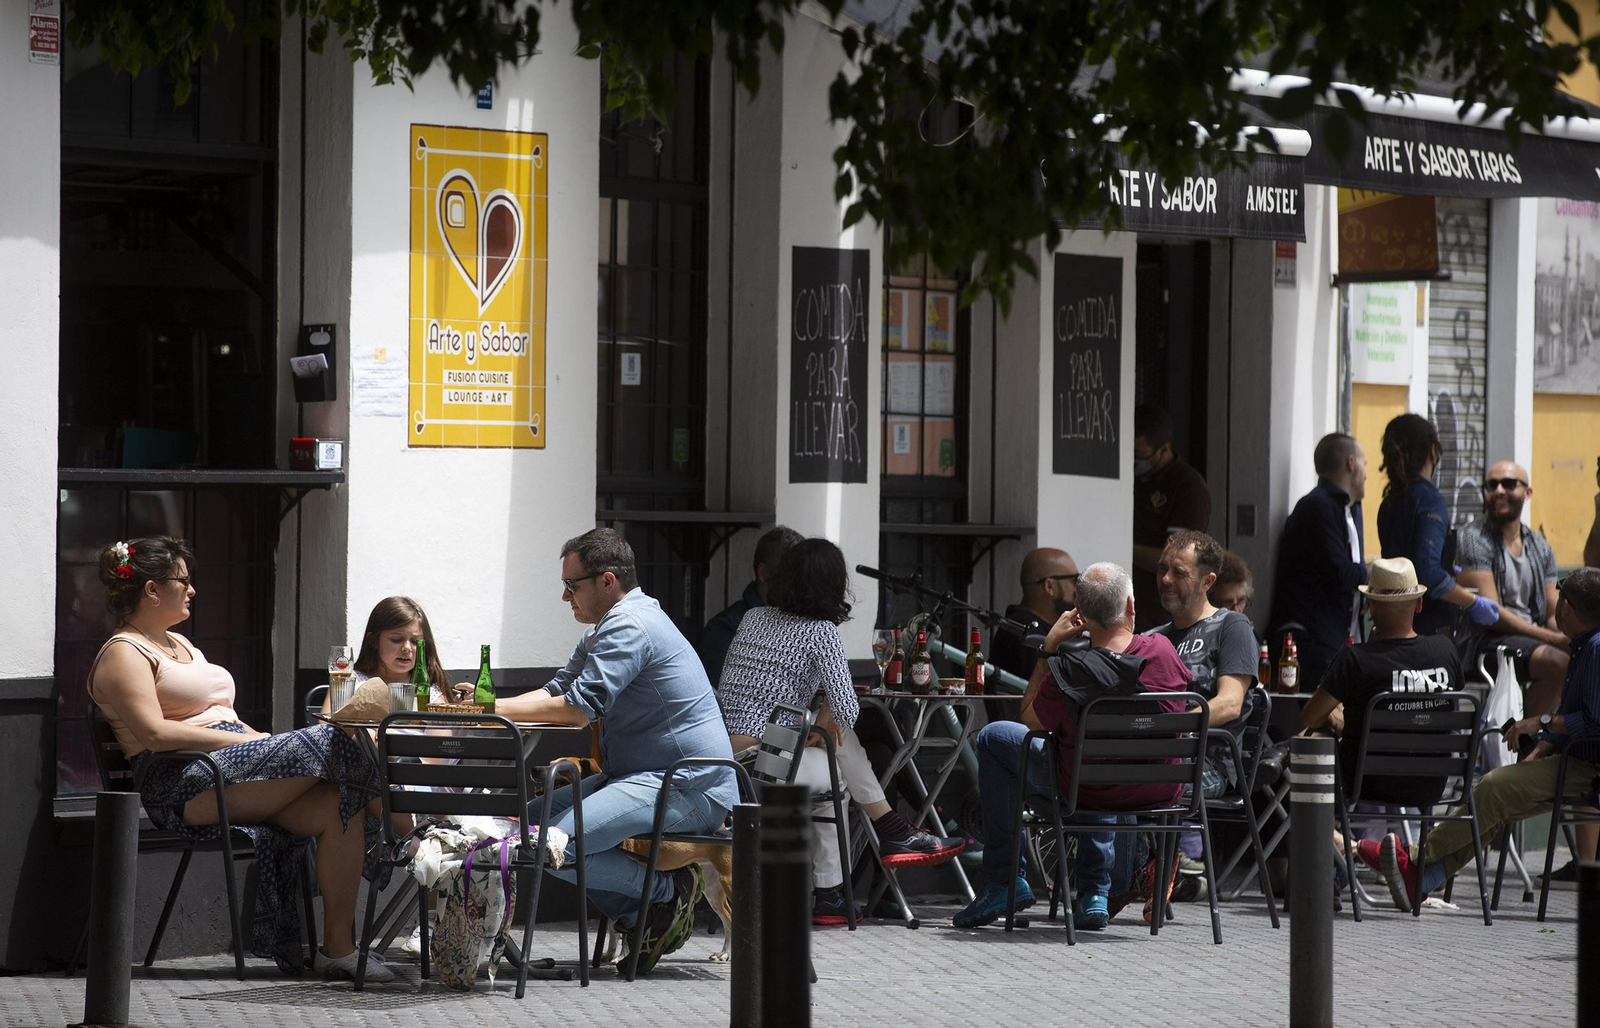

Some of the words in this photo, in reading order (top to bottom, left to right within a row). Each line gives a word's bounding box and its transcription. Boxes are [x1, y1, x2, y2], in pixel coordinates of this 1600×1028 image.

[31, 17, 58, 29] Alarma
[1364, 136, 1402, 173] ARTE
[1404, 141, 1414, 174] Y
[1418, 141, 1475, 180] SABOR
[1469, 149, 1522, 184] TAPAS
[1099, 168, 1141, 207] RTE
[1144, 171, 1156, 208] Y
[1246, 184, 1298, 215] AMSTEL
[794, 278, 866, 343] COMIDA
[1057, 294, 1117, 342] COMIDA
[428, 322, 461, 351] Arte
[467, 334, 476, 361] y
[481, 324, 528, 353] Sabor
[447, 371, 477, 382] FUSION
[479, 373, 509, 384] CUISINE
[806, 344, 851, 399] PARA
[1070, 349, 1104, 391] PARA
[448, 391, 483, 403] LOUNGE
[491, 392, 508, 403] ART
[1059, 389, 1115, 443] LLEVAR
[794, 400, 861, 464] LLEVAR
[1388, 703, 1393, 711] 4
[1394, 701, 1424, 711] OCTUBRE
[1425, 700, 1434, 709] EN
